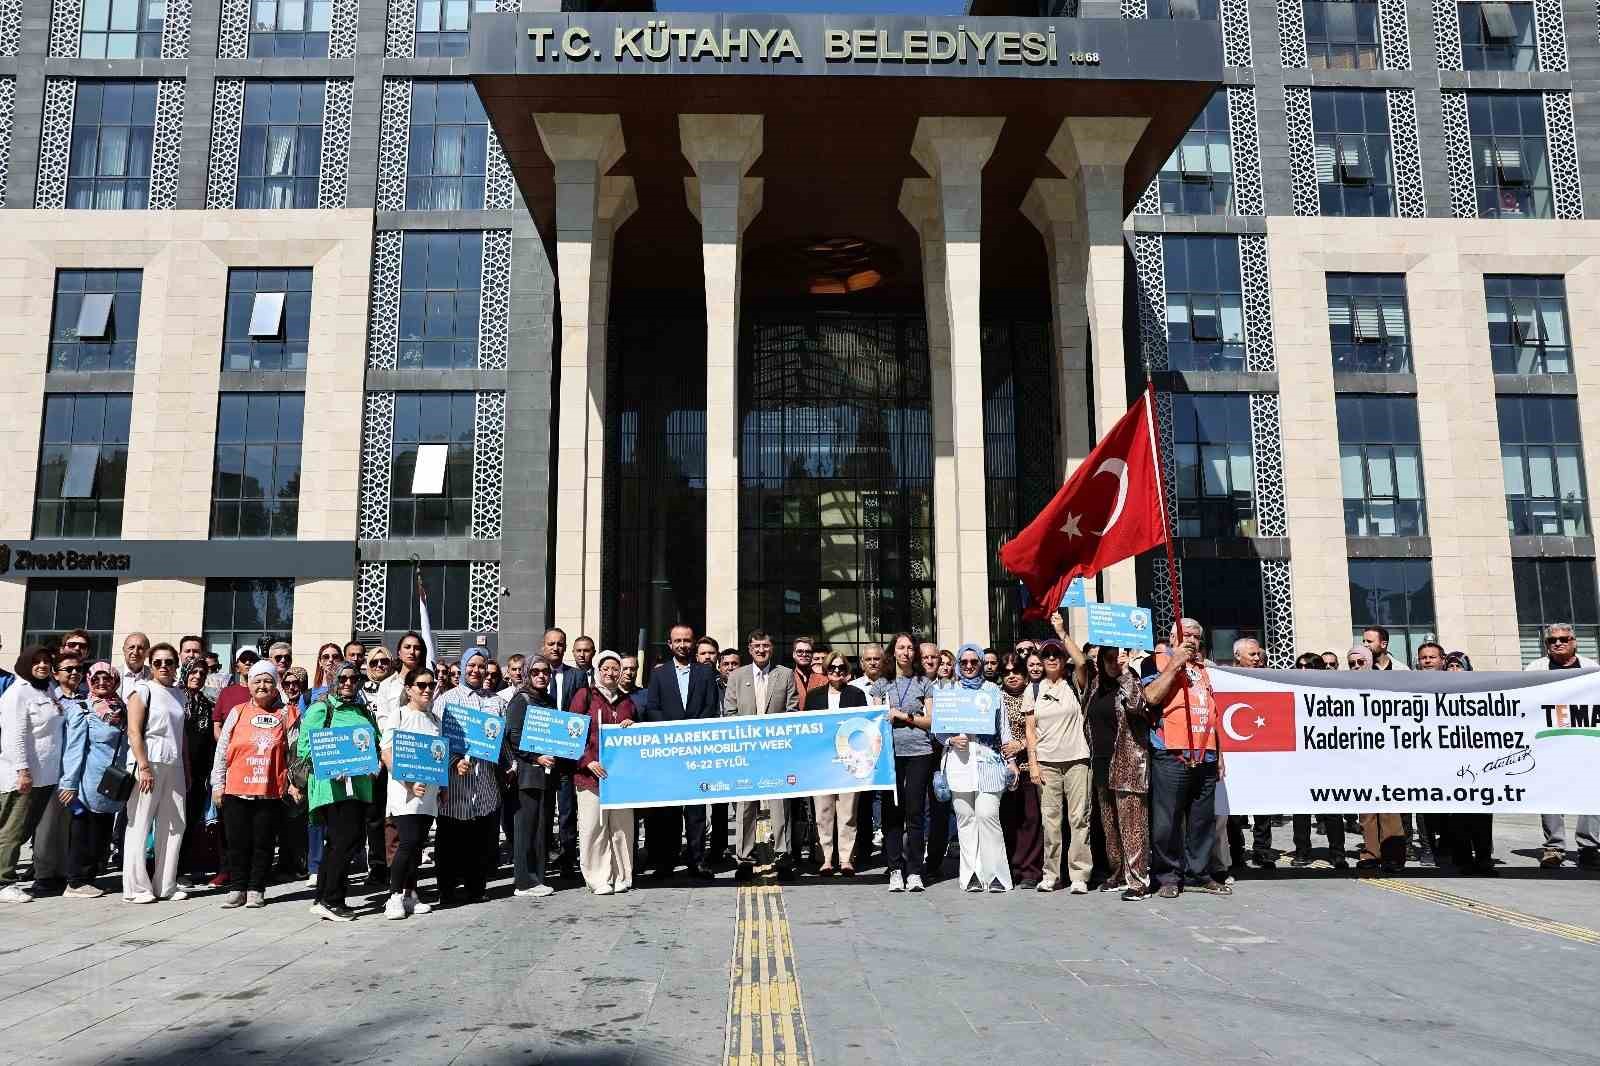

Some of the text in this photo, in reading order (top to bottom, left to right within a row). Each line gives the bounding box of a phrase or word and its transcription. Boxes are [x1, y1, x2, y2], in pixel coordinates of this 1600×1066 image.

[527, 27, 601, 61] T.C.
[614, 20, 803, 63] KÜTAHYA
[824, 24, 1057, 65] BELEDİYESİ
[15, 550, 130, 570] Ziraat Bankası
[1303, 693, 1355, 717] Vatan
[1359, 693, 1429, 723] Toprağı
[604, 722, 824, 748] AVRUPA HAREKETLİLİK HAFTASI
[1303, 725, 1385, 750] Kaderine
[1389, 725, 1432, 750] Terk
[640, 738, 793, 759] EUROPEAN MOBILITY WEEK
[685, 756, 750, 771] 16-22 EYLÜL
[1310, 784, 1526, 806] www.tema.org.tr
